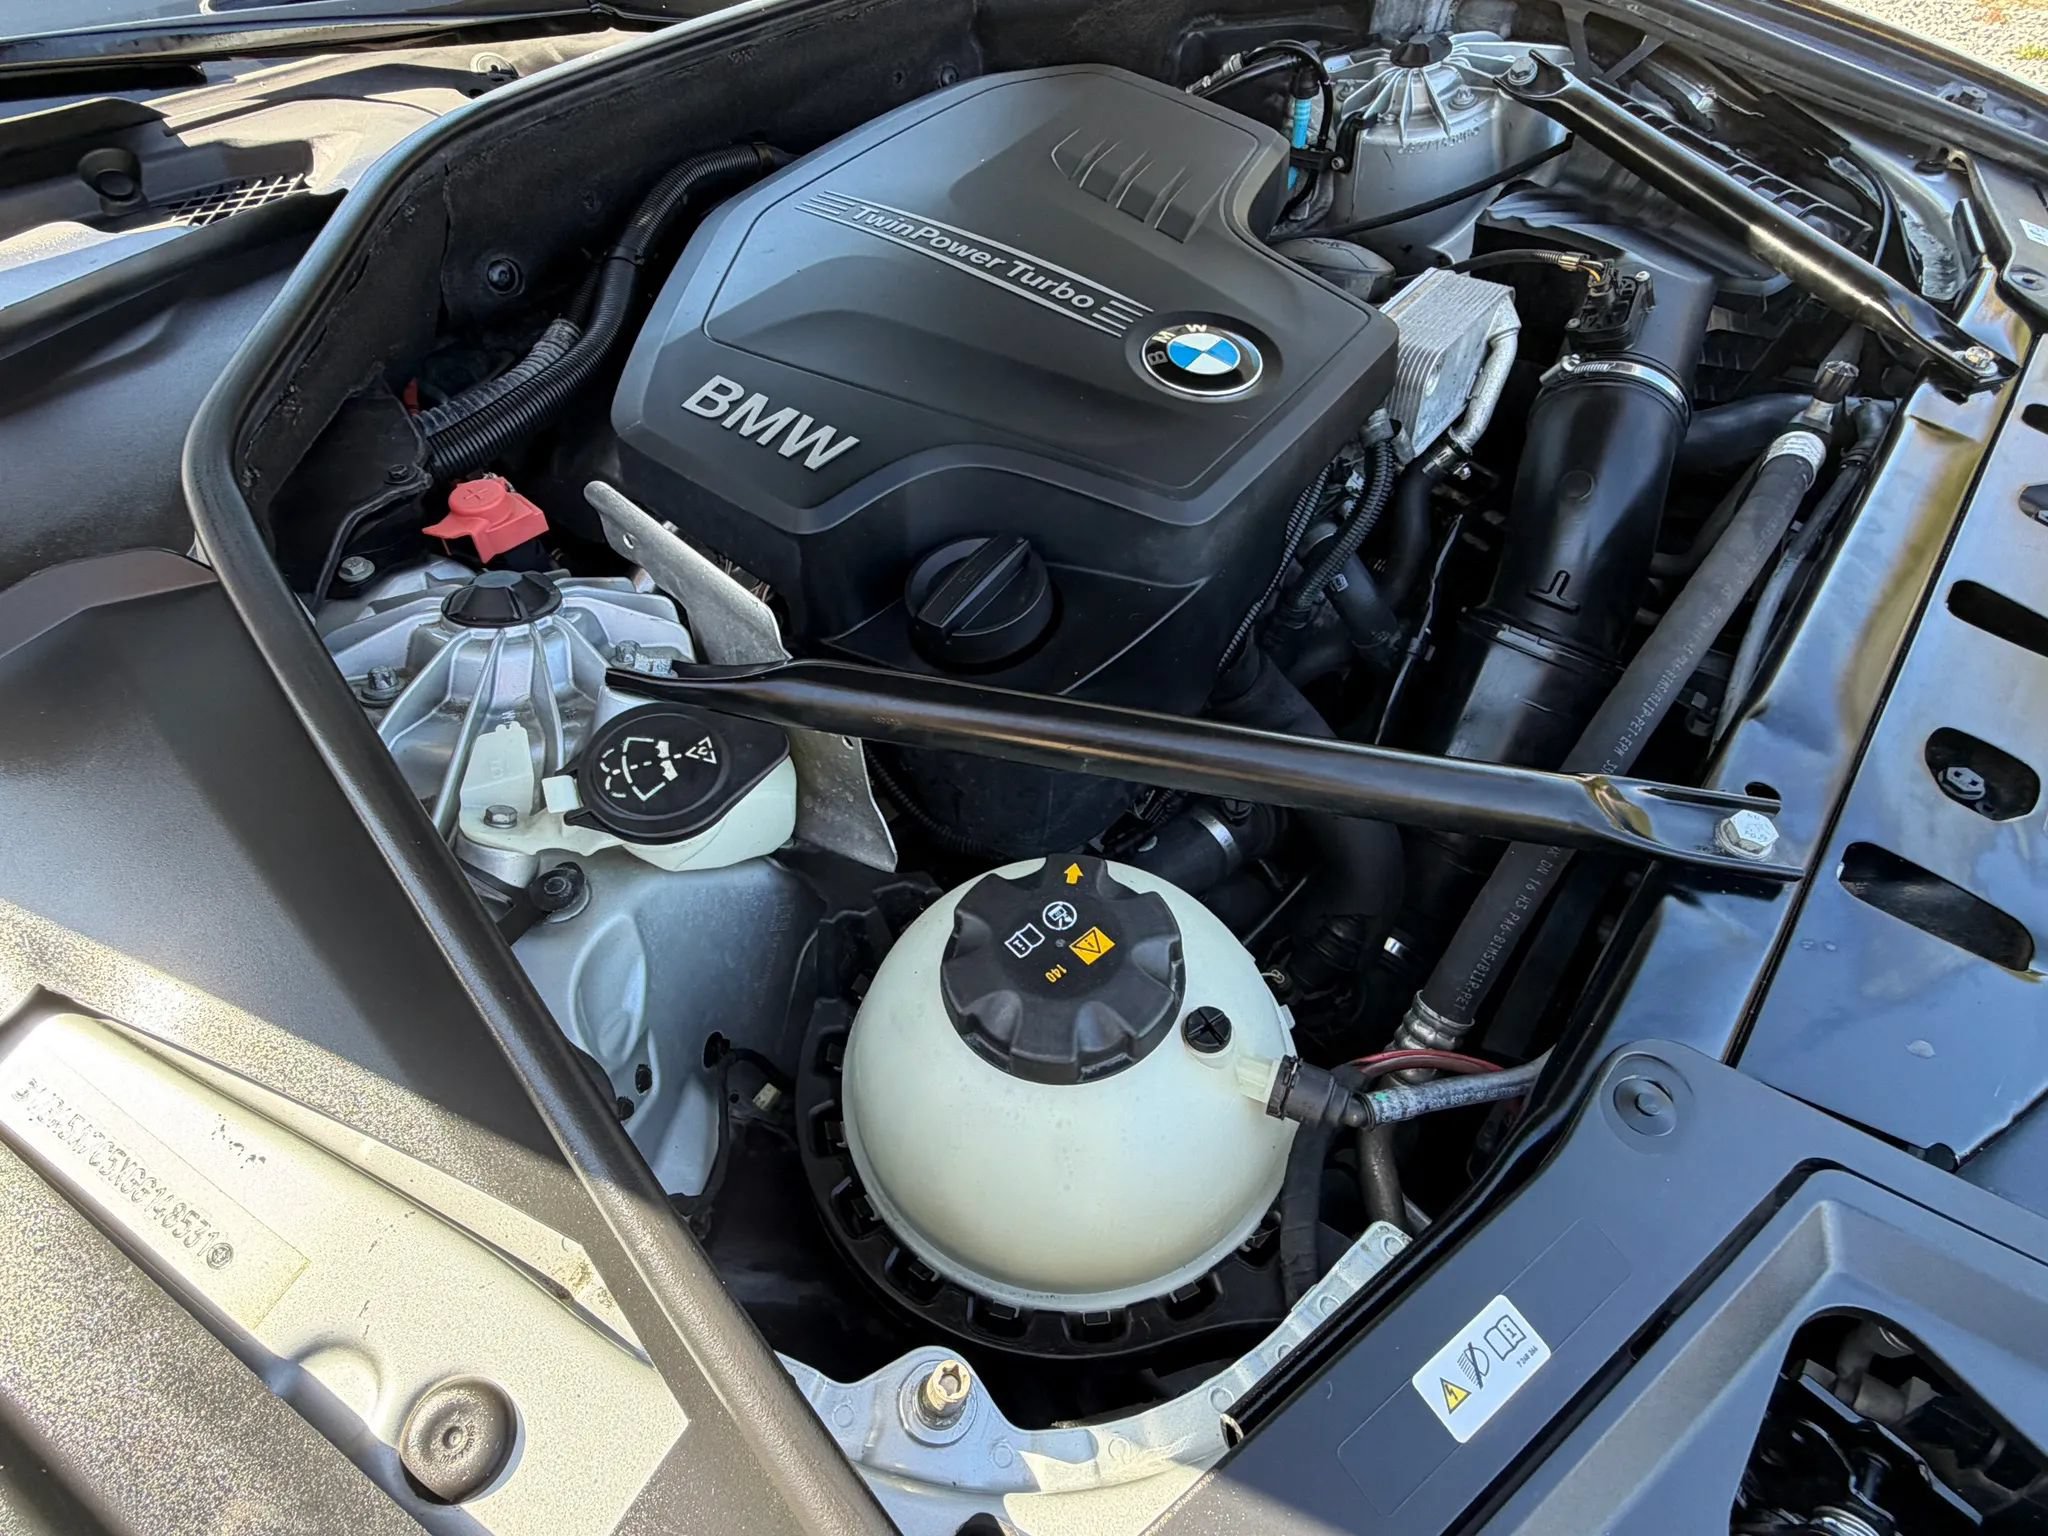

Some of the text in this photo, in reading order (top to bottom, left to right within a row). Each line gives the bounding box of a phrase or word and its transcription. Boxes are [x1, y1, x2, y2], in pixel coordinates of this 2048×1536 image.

[852, 206, 1095, 309] TwinPower Turbo
[1147, 324, 1208, 366] BMW
[681, 375, 860, 471] BMW
[1045, 963, 1067, 983] 140
